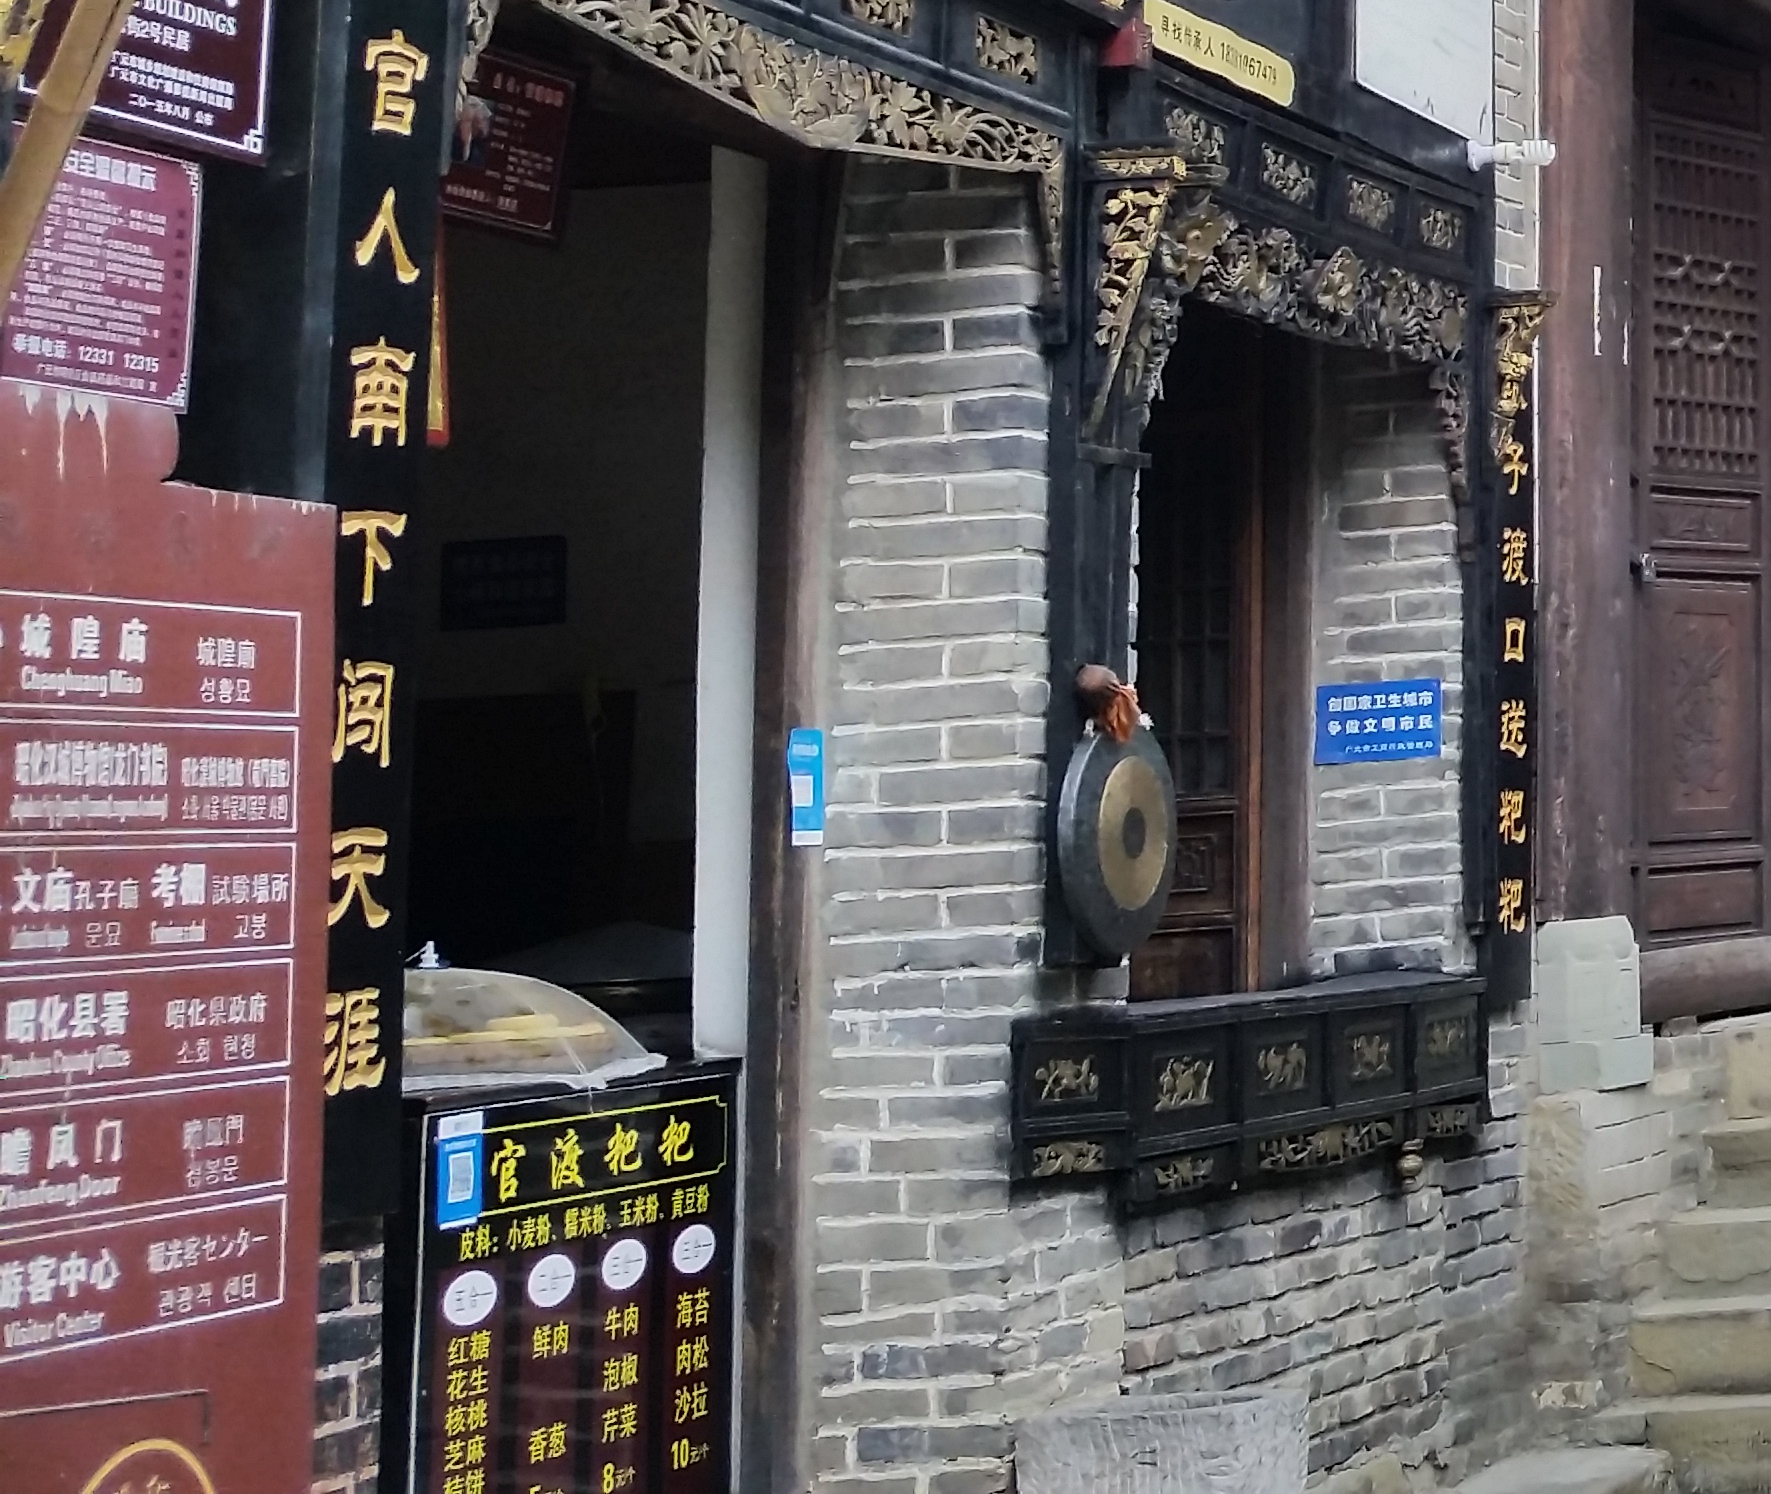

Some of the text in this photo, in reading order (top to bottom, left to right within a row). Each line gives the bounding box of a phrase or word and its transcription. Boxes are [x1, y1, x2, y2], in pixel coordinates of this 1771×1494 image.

[121, 14, 192, 52] 街2号民居
[78, 344, 115, 366] 12331
[123, 352, 160, 374] 12315
[20, 613, 148, 663] 城隍庙
[1496, 351, 1533, 934] 子渡口送粑粑
[1327, 714, 1434, 737] 争做文明市民
[11, 866, 74, 914] 文庙
[5, 989, 130, 1044] 昭化县署
[490, 1114, 694, 1203] 官渡粑粑
[604, 1303, 640, 1341] 牛肉
[676, 1288, 710, 1328] 海苔
[447, 1329, 492, 1367] 红糖
[531, 1320, 570, 1360] 鲜肉
[675, 1336, 710, 1376] 肉松
[446, 1365, 489, 1401] 花生
[602, 1353, 639, 1392] 泡椒
[444, 1401, 488, 1437] 核桃
[674, 1383, 708, 1423] 沙拉
[528, 1422, 567, 1464] 香葱
[601, 1403, 638, 1444] 芹菜
[443, 1435, 487, 1472] 芝麻
